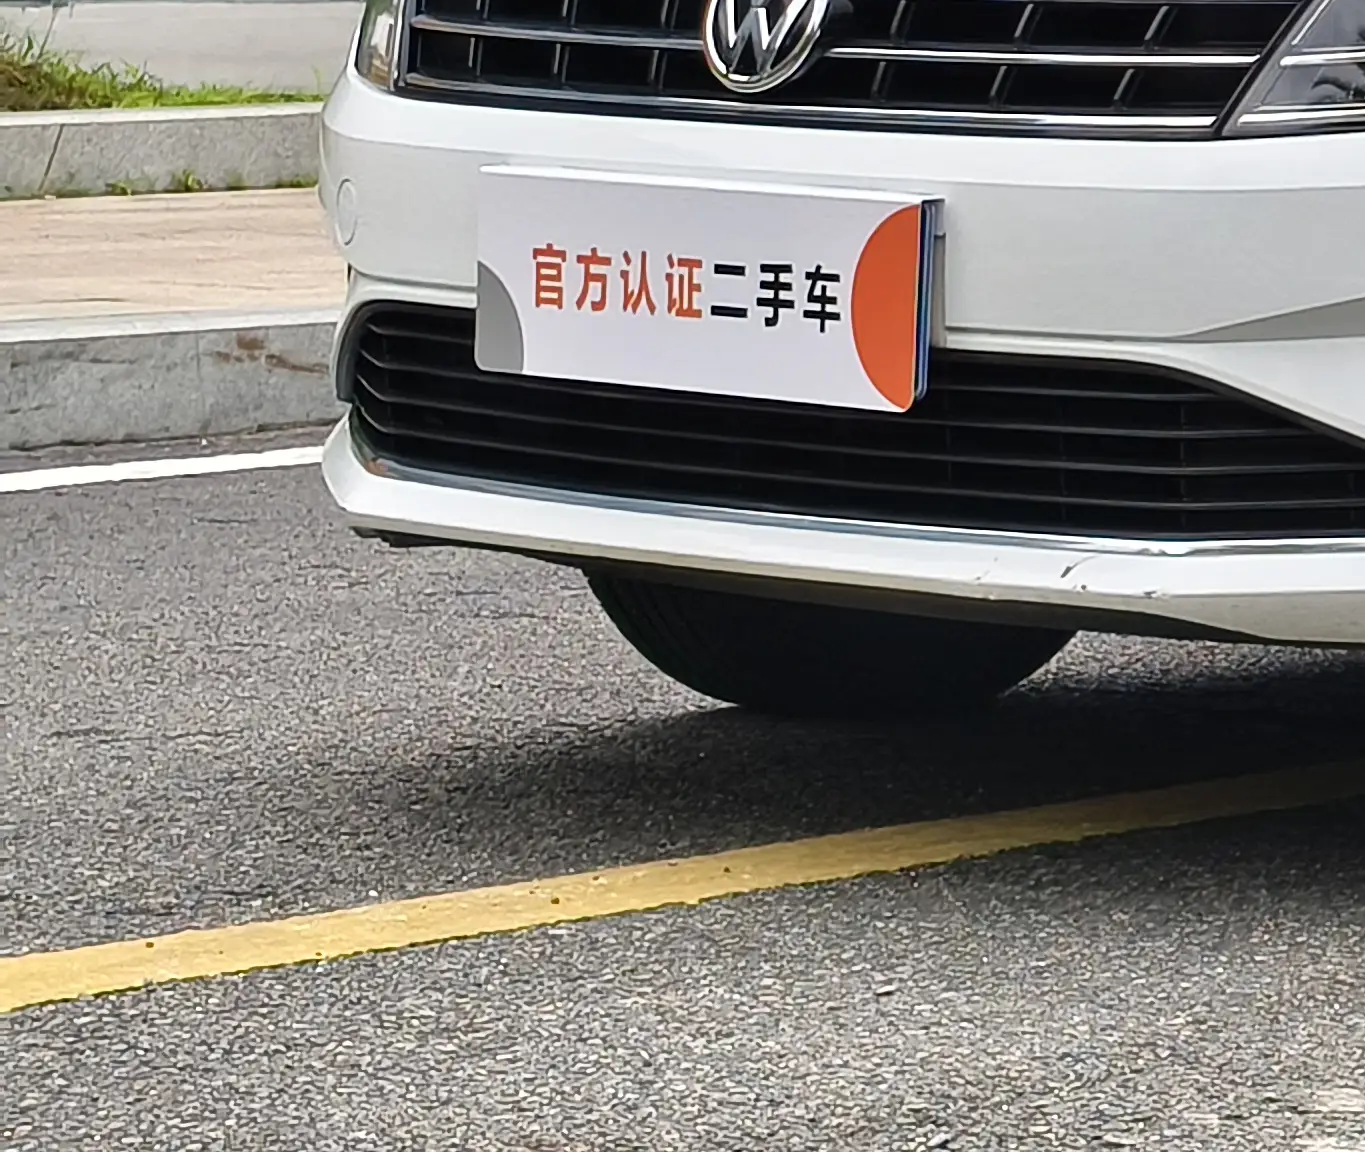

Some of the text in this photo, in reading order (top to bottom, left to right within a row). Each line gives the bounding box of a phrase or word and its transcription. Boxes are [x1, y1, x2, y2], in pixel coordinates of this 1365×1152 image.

[531, 243, 842, 333] 官方认证二手车
